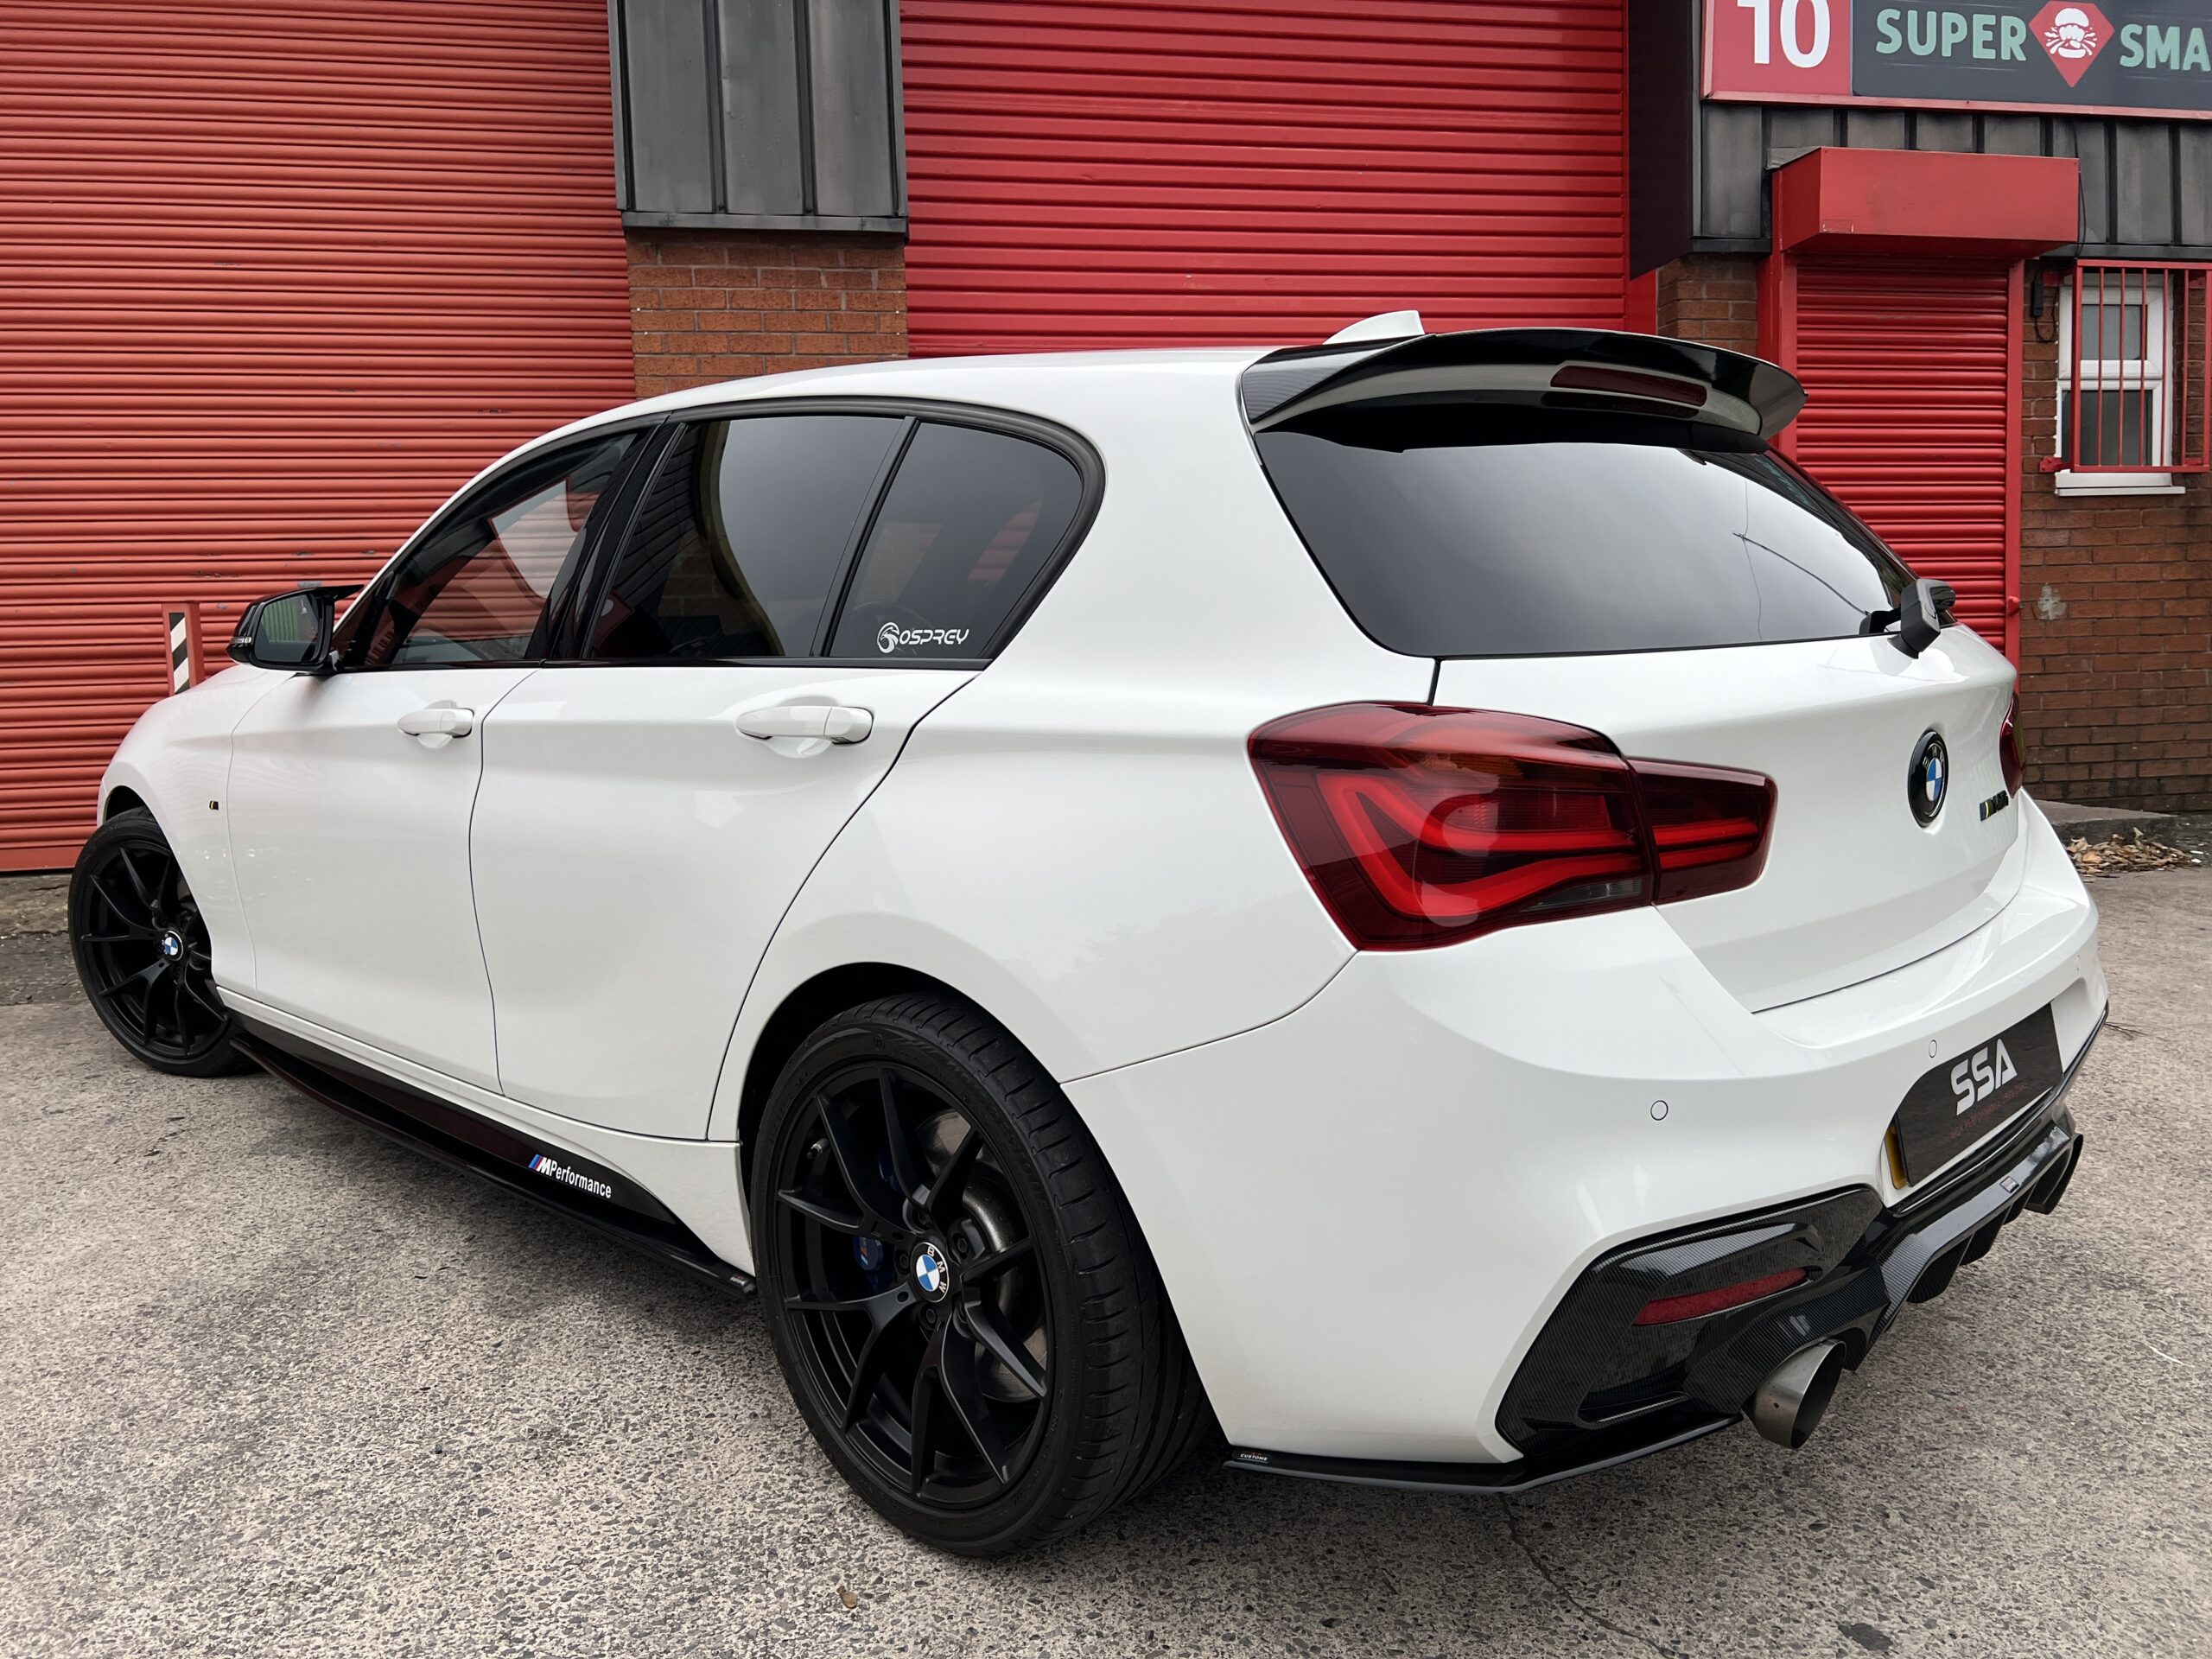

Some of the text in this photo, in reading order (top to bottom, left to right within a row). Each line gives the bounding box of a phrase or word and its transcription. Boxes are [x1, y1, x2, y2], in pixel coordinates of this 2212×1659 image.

[1737, 0, 1830, 68] 10
[1875, 9, 2027, 62] SUPER
[899, 628, 969, 645] OSPREY
[1950, 1038, 2018, 1116] SSA
